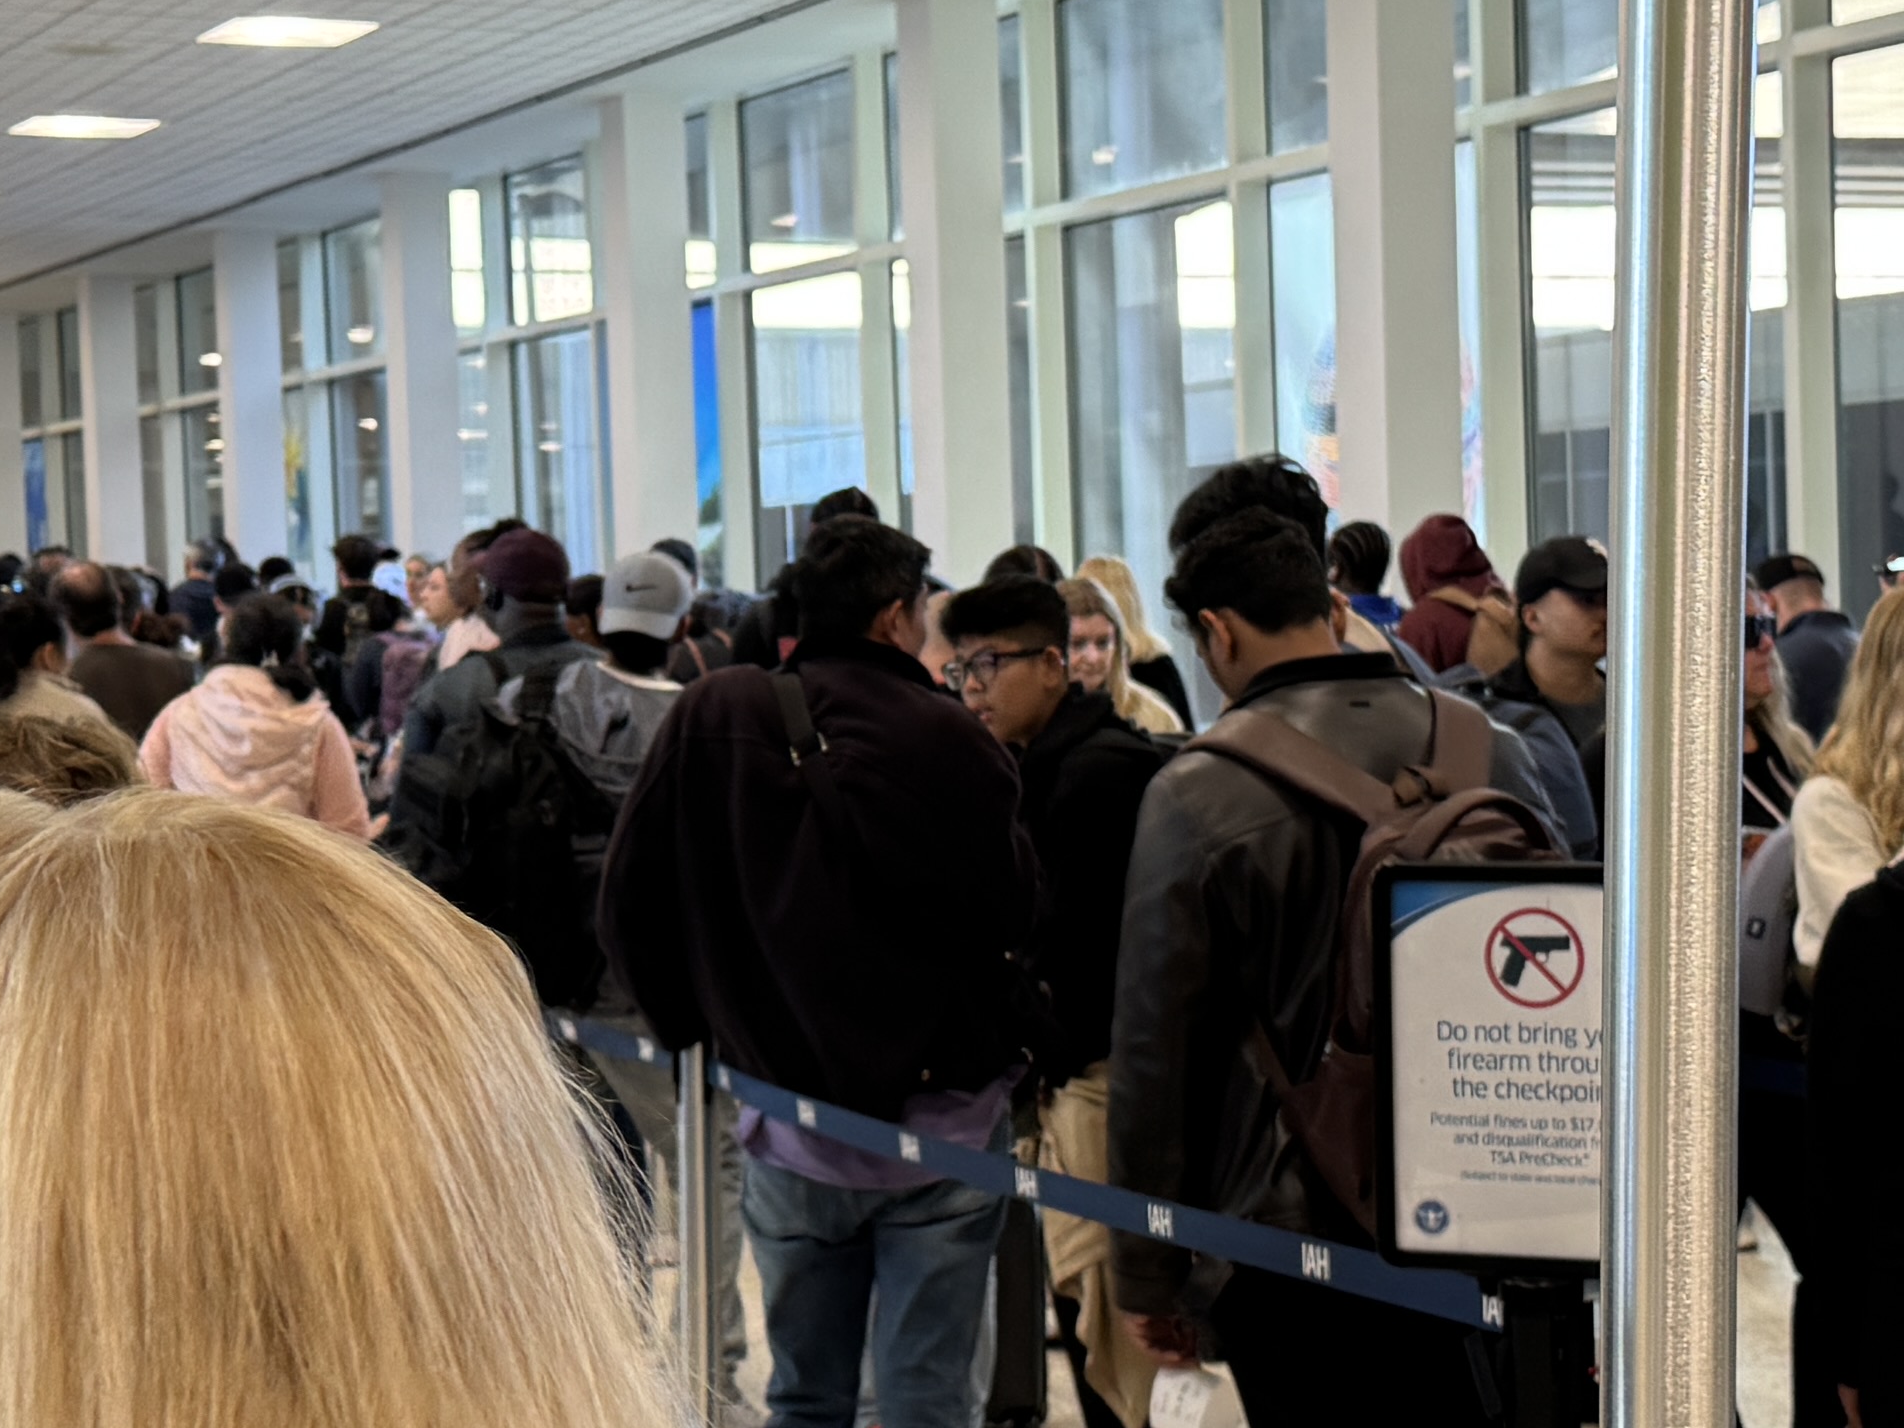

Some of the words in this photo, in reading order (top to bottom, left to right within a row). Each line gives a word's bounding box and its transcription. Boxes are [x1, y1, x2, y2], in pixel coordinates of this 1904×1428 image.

[1436, 1020, 1467, 1042] Do
[1474, 1022, 1512, 1044] not
[1518, 1021, 1578, 1049] bring
[1448, 1047, 1531, 1071] firearm
[1452, 1076, 1488, 1099] the
[1430, 1111, 1490, 1128] Potential
[1494, 1113, 1528, 1129] fines
[1530, 1117, 1549, 1131] up
[1551, 1116, 1566, 1131] to
[1453, 1131, 1479, 1146] and
[1482, 1132, 1588, 1149] disqualification
[1490, 1150, 1516, 1165] TSA
[1147, 1202, 1174, 1239] IAH
[1301, 1241, 1331, 1283] IAH
